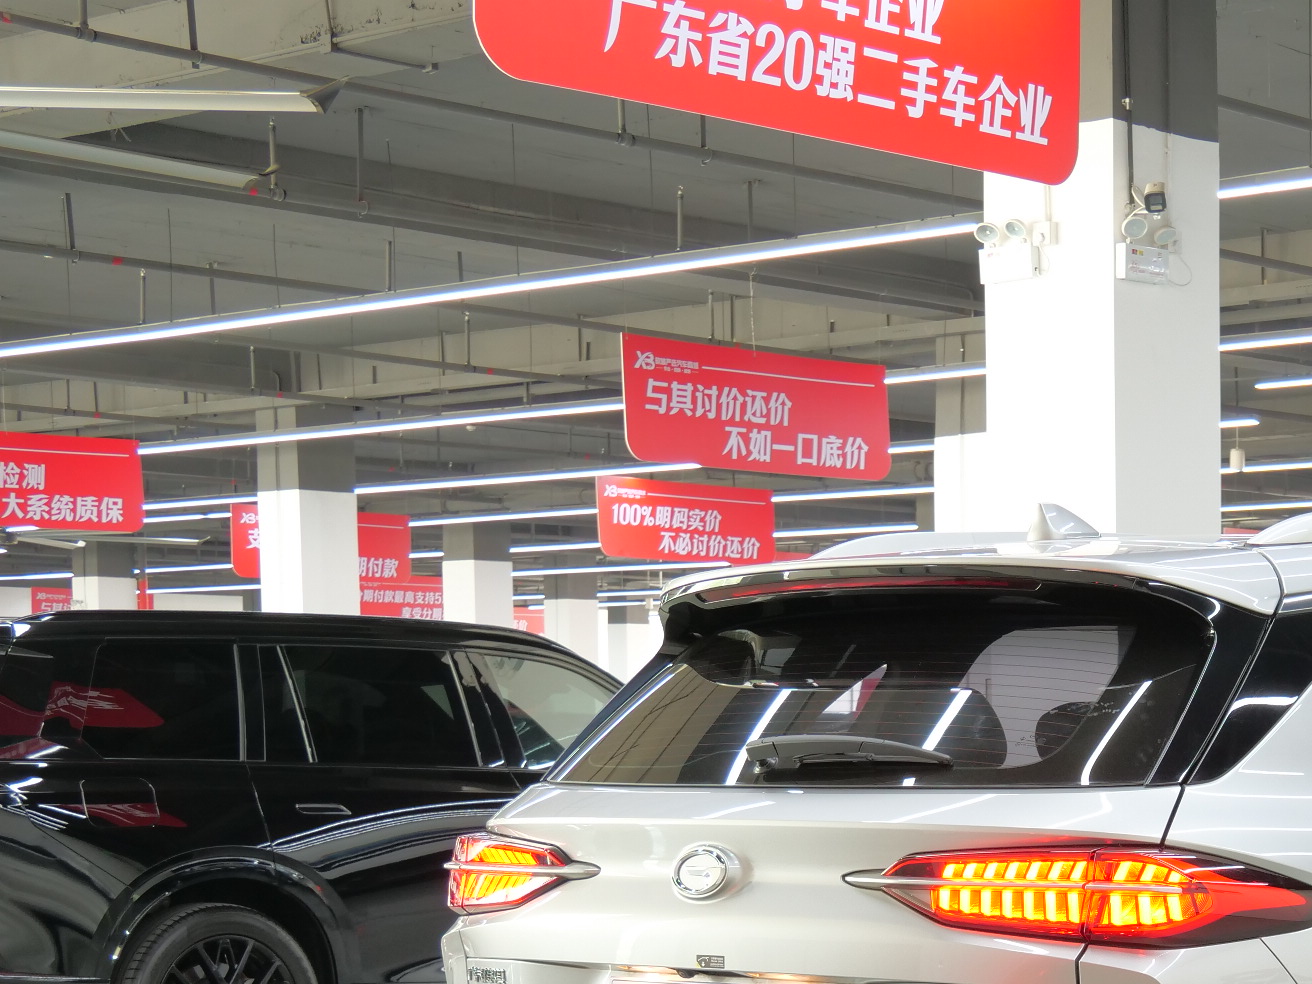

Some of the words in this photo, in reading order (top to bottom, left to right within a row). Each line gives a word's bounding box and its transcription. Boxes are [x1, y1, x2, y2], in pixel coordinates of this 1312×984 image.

[604, 0, 1053, 146] 广东省20强二手车企业
[645, 378, 792, 426] 与其讨价还价
[722, 426, 868, 470] 不如一口底价
[2, 493, 124, 524] 大系统质保
[612, 503, 722, 533] 100%明码实价
[659, 531, 761, 560] 不必讨价还价
